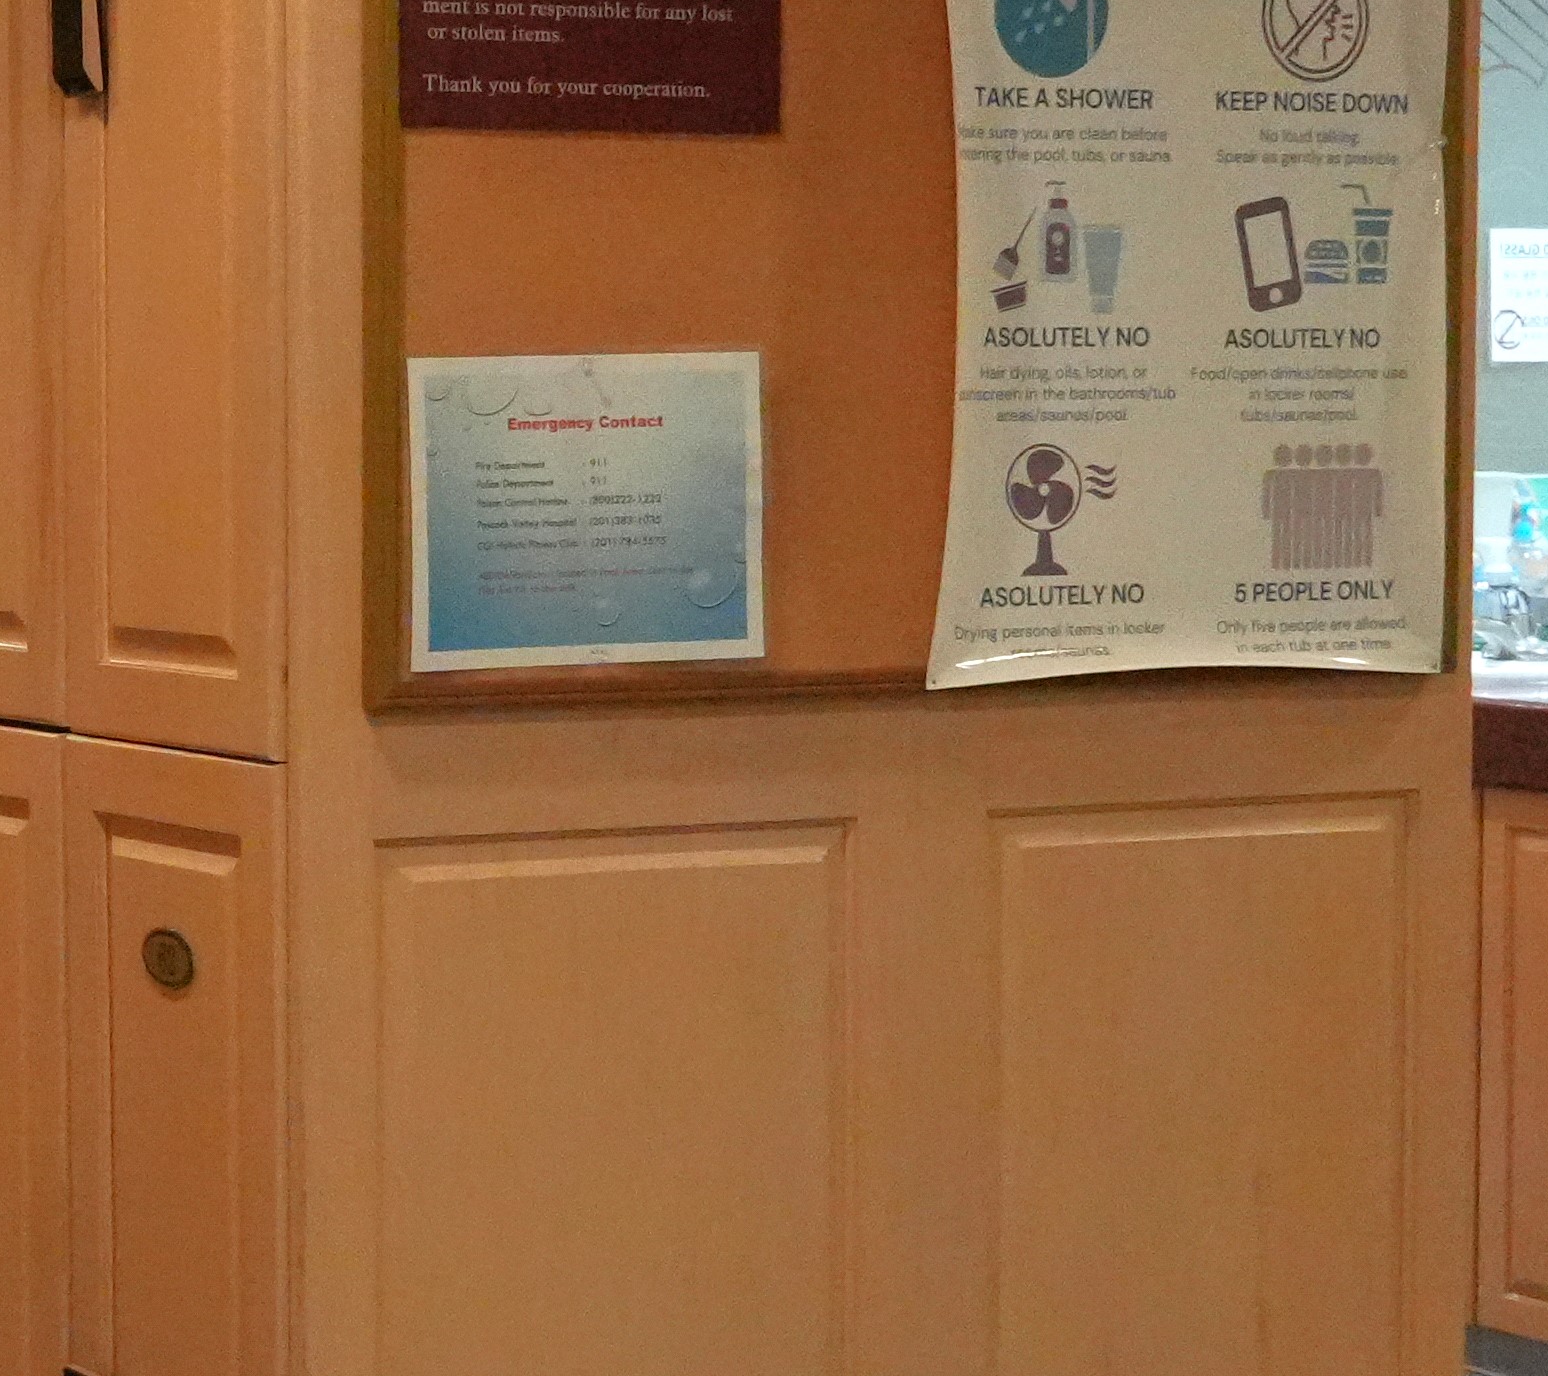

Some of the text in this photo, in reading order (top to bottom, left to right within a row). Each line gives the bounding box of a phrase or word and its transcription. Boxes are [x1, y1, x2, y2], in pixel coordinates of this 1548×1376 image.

[475, 0, 489, 15] is
[495, 0, 525, 17] not
[530, 1, 630, 21] responsible
[636, 3, 660, 20] for
[665, 7, 696, 24] any
[702, 4, 732, 22] lost
[427, 24, 564, 43] or stolen items.
[423, 73, 710, 100] Thank you for your cooperation.
[975, 87, 1153, 110] TAKE A SHOWER
[1216, 91, 1408, 114] KEEP NOISE DOWN
[1022, 129, 1049, 142] you
[1052, 129, 1075, 140] are
[1006, 148, 1029, 161] the
[1110, 149, 1124, 162] or
[984, 327, 1149, 347] ASOLUTELY NO
[1225, 328, 1380, 348] ASOLUTELY NO
[1043, 388, 1066, 399] the
[507, 415, 663, 433] Emergency Contact
[981, 584, 1144, 608] ASOLUTELY NO
[1235, 580, 1395, 602] 5 PEOPLE ONLY
[955, 626, 998, 642] Drying
[1002, 624, 1060, 642] personal
[1124, 622, 1165, 634] locker
[1217, 620, 1248, 635] Only
[1280, 618, 1327, 633] people
[1330, 621, 1351, 631] are
[1253, 641, 1285, 653] each
[1289, 640, 1311, 652] tub
[1333, 642, 1356, 651] one
